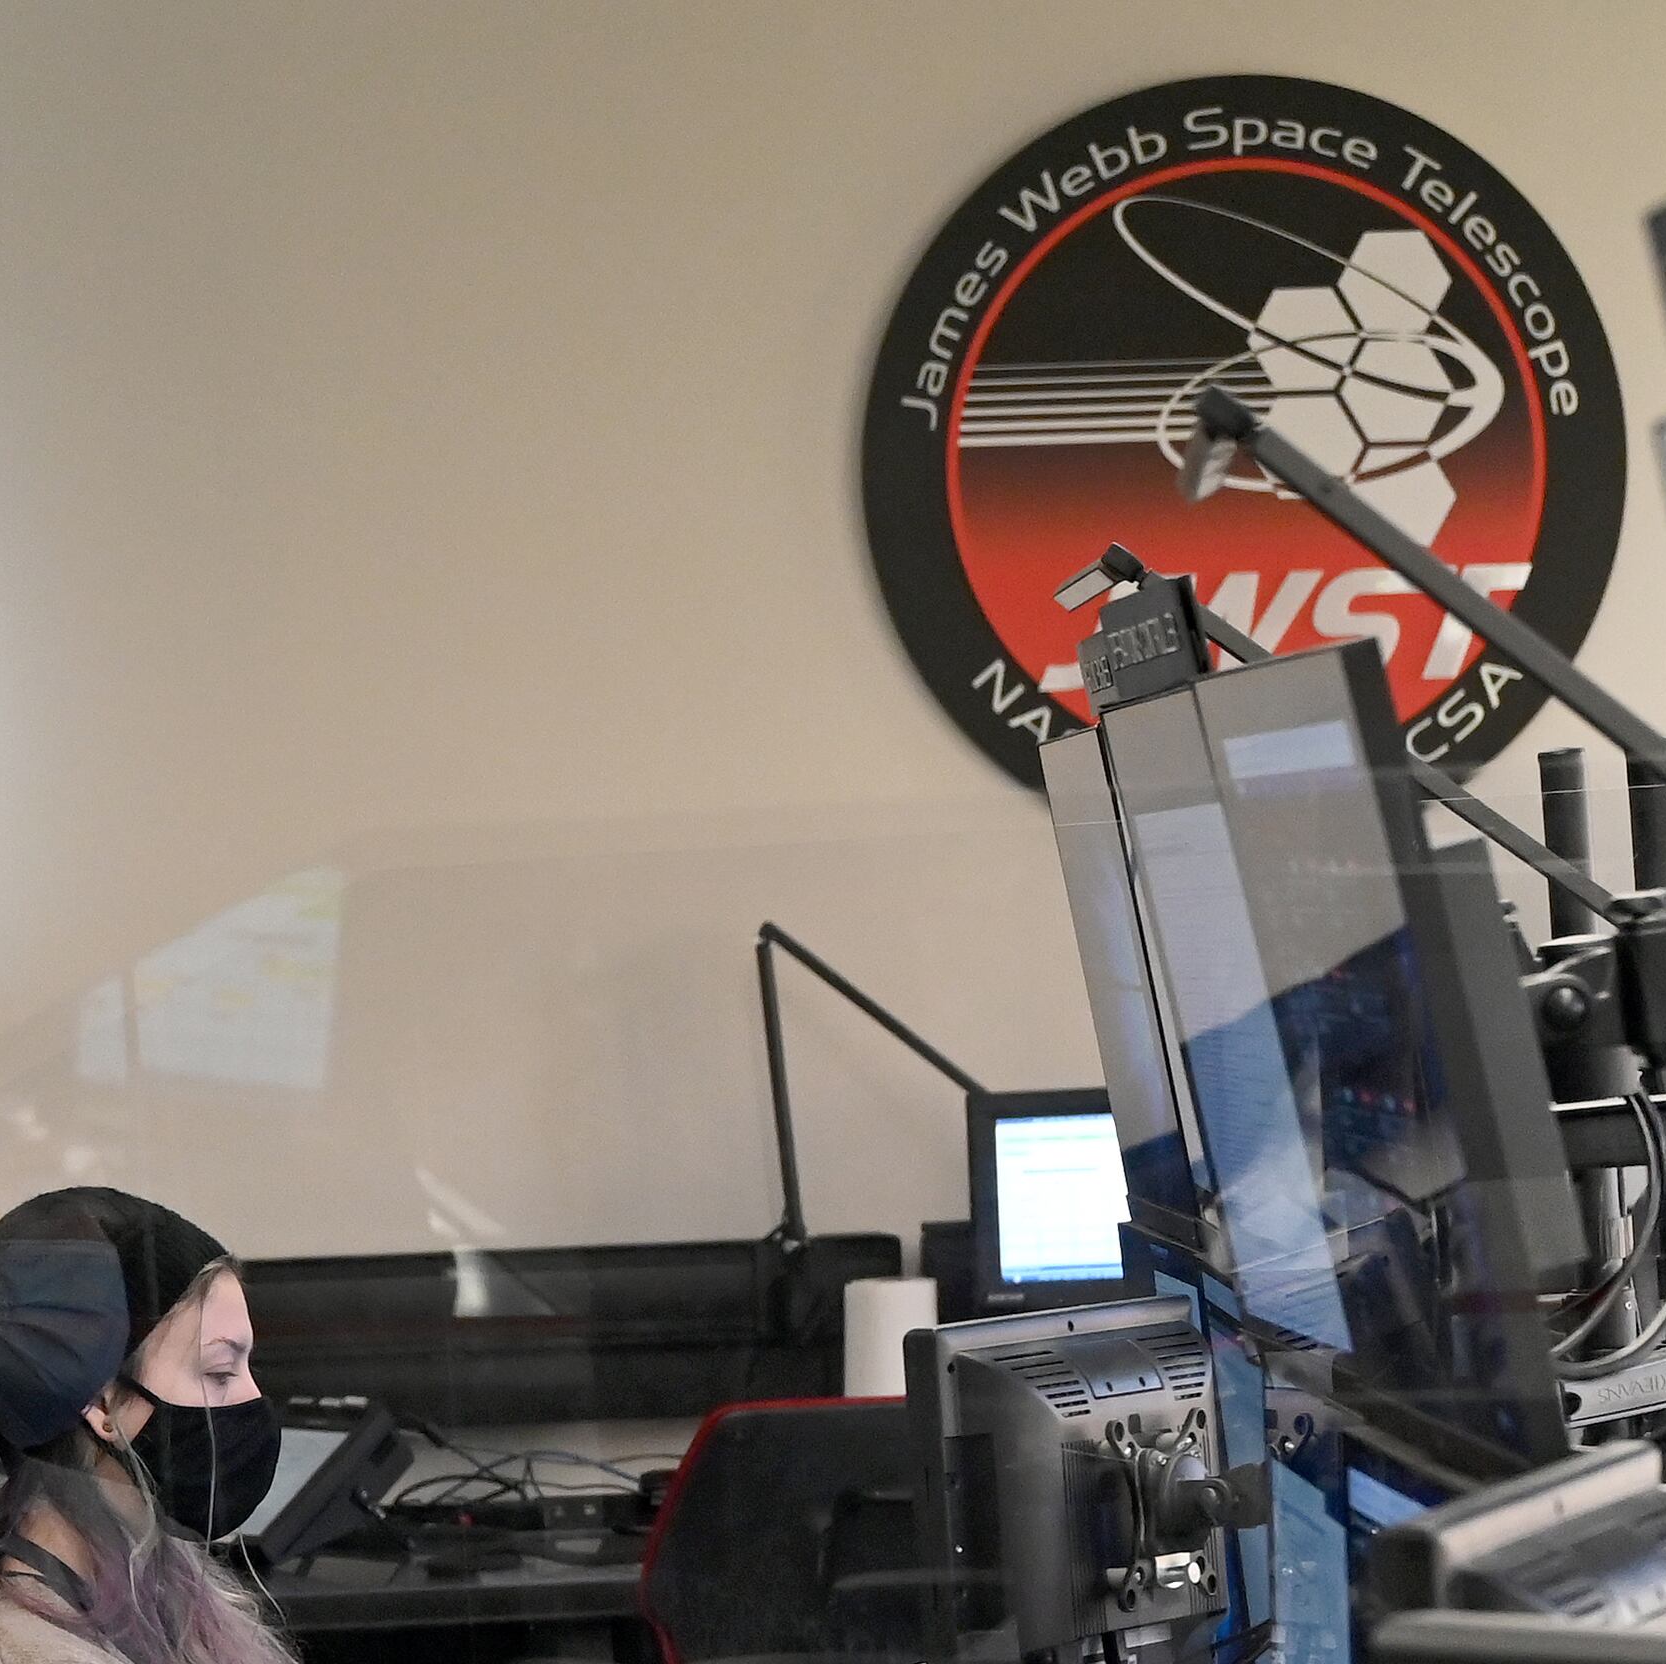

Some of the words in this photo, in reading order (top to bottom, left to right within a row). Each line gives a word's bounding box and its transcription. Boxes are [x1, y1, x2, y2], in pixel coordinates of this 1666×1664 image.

[901, 240, 1010, 430] James
[997, 126, 1168, 234] Webb
[1183, 106, 1379, 169] Space
[1401, 145, 1580, 417] Telescope
[1405, 661, 1525, 764] CSA
